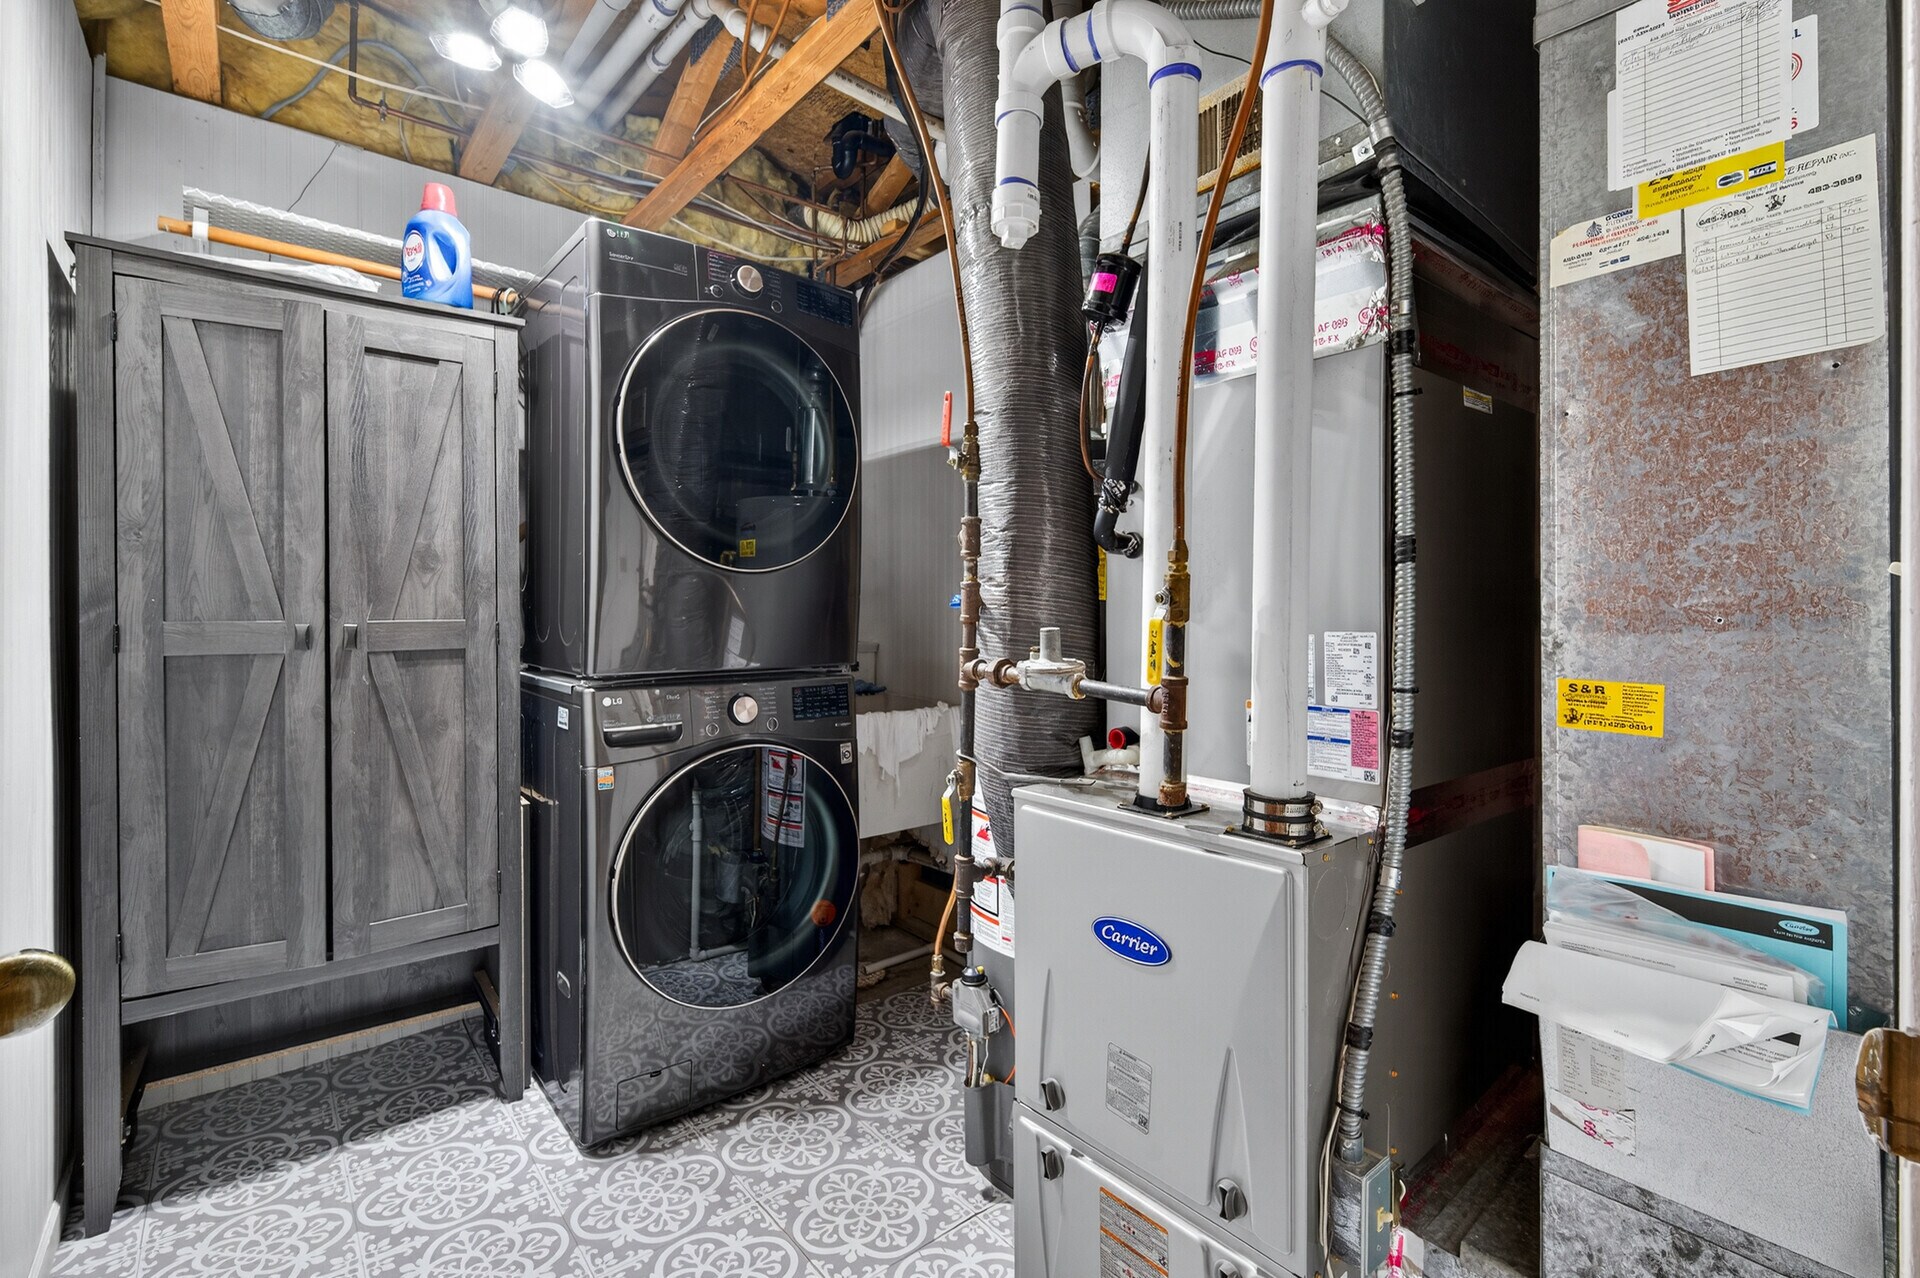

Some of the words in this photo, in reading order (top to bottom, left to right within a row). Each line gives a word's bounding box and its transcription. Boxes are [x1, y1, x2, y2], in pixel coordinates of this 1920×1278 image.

[1568, 683, 1578, 693] S
[1580, 684, 1592, 694] &
[1594, 685, 1606, 695] R
[612, 697, 623, 705] LG
[1101, 924, 1159, 956] Carrier
